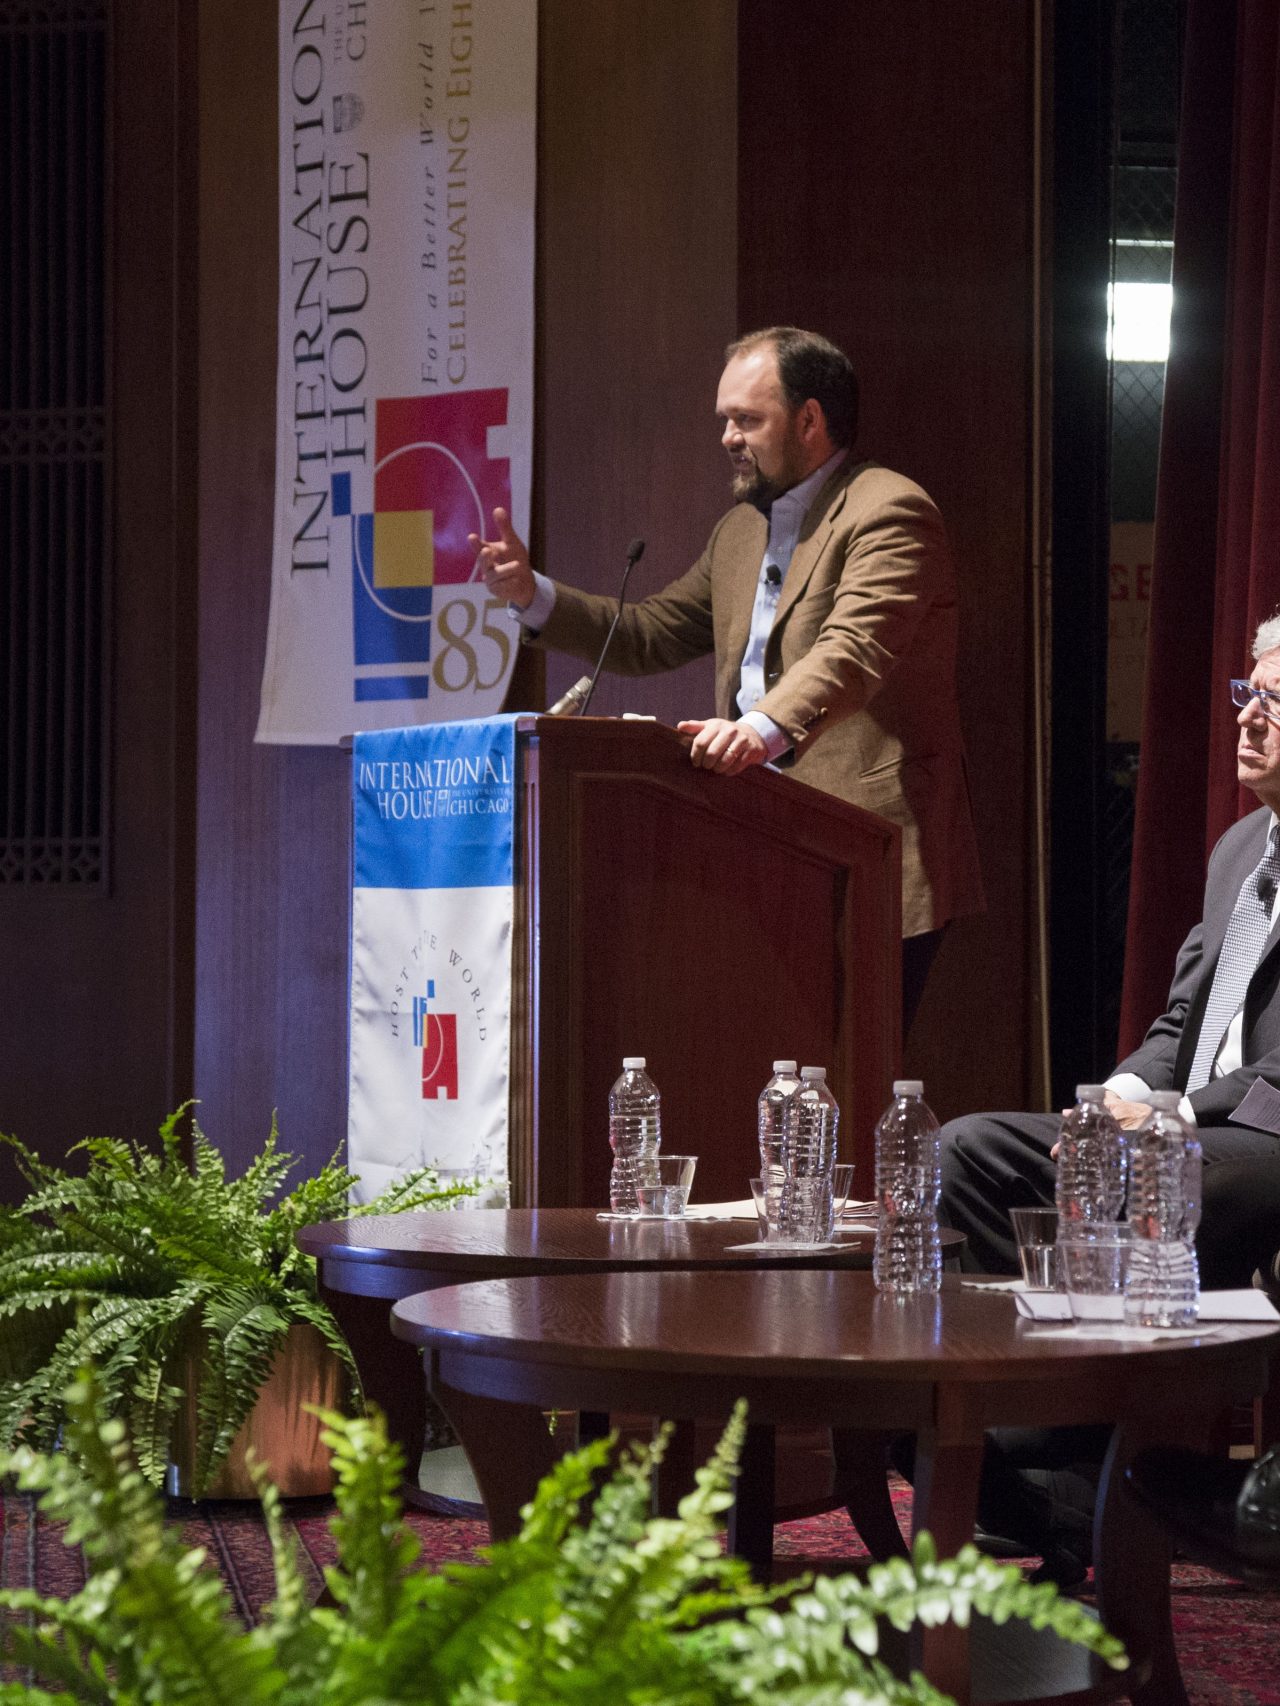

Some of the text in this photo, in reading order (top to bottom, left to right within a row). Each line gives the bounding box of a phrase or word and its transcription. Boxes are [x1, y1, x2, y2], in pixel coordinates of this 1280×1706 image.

[417, 42, 436, 146] World
[420, 166, 438, 271] Better
[446, 115, 472, 385] CELEBRATING
[326, 151, 370, 464] HOUSE
[427, 293, 438, 310] a
[420, 326, 438, 387] For
[431, 598, 511, 694] 85
[376, 789, 432, 820] HOUE
[450, 798, 510, 816] CHICAGO
[449, 949, 488, 1042] WORLD
